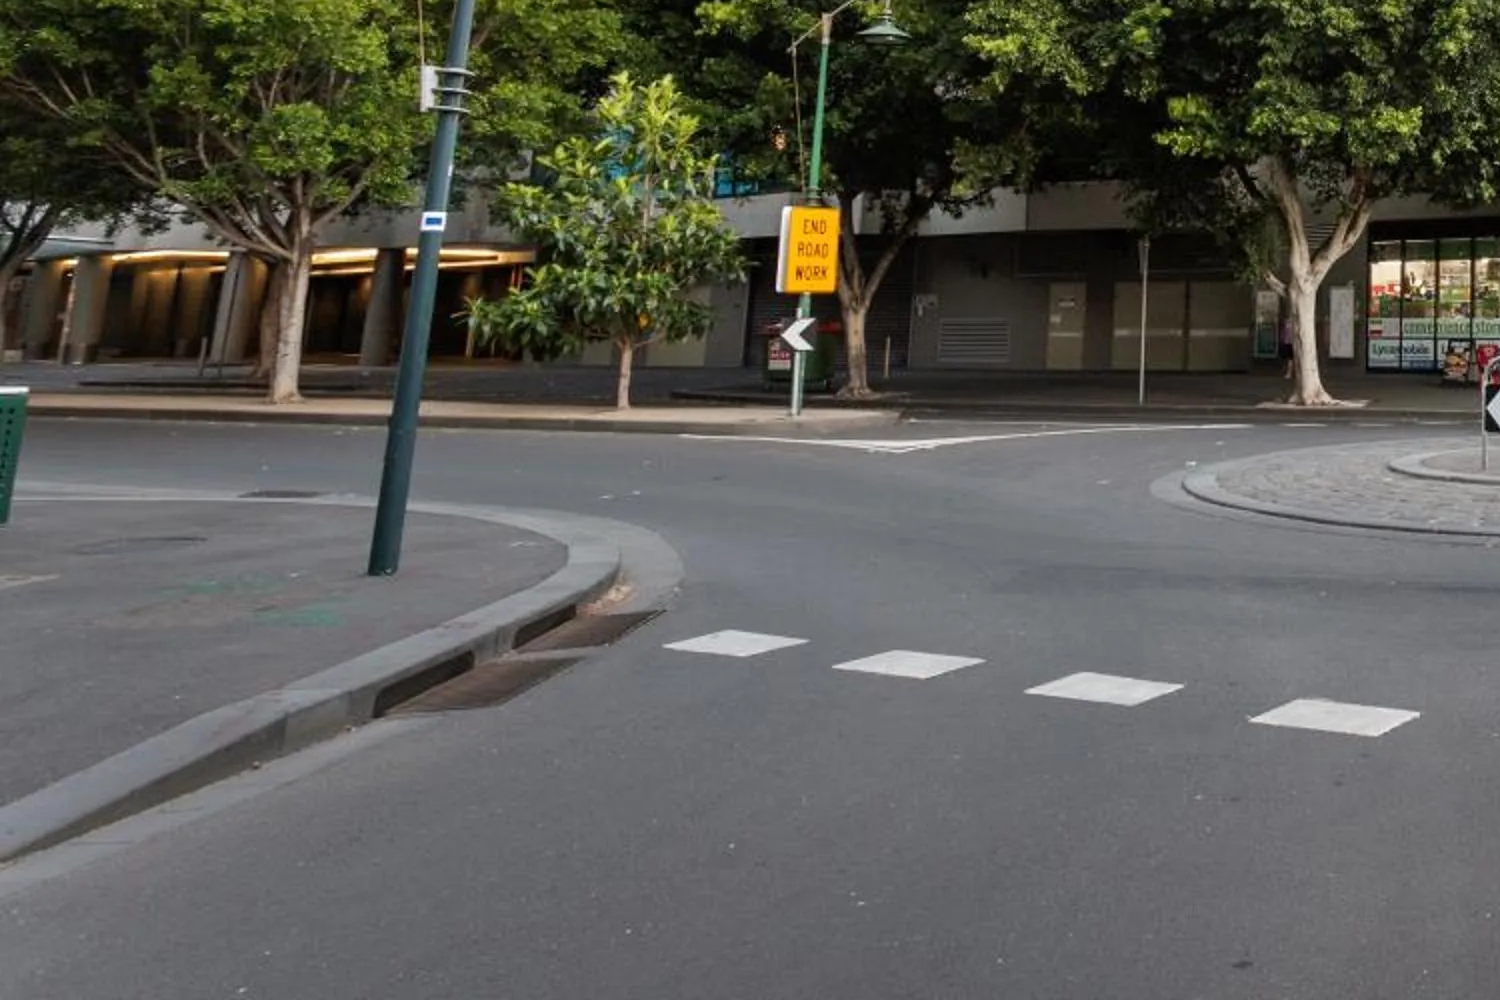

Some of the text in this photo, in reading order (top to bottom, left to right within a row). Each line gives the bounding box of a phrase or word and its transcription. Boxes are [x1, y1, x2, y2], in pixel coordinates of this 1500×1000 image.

[803, 218, 827, 235] END
[797, 242, 829, 259] ROAD
[795, 265, 828, 281] WORK
